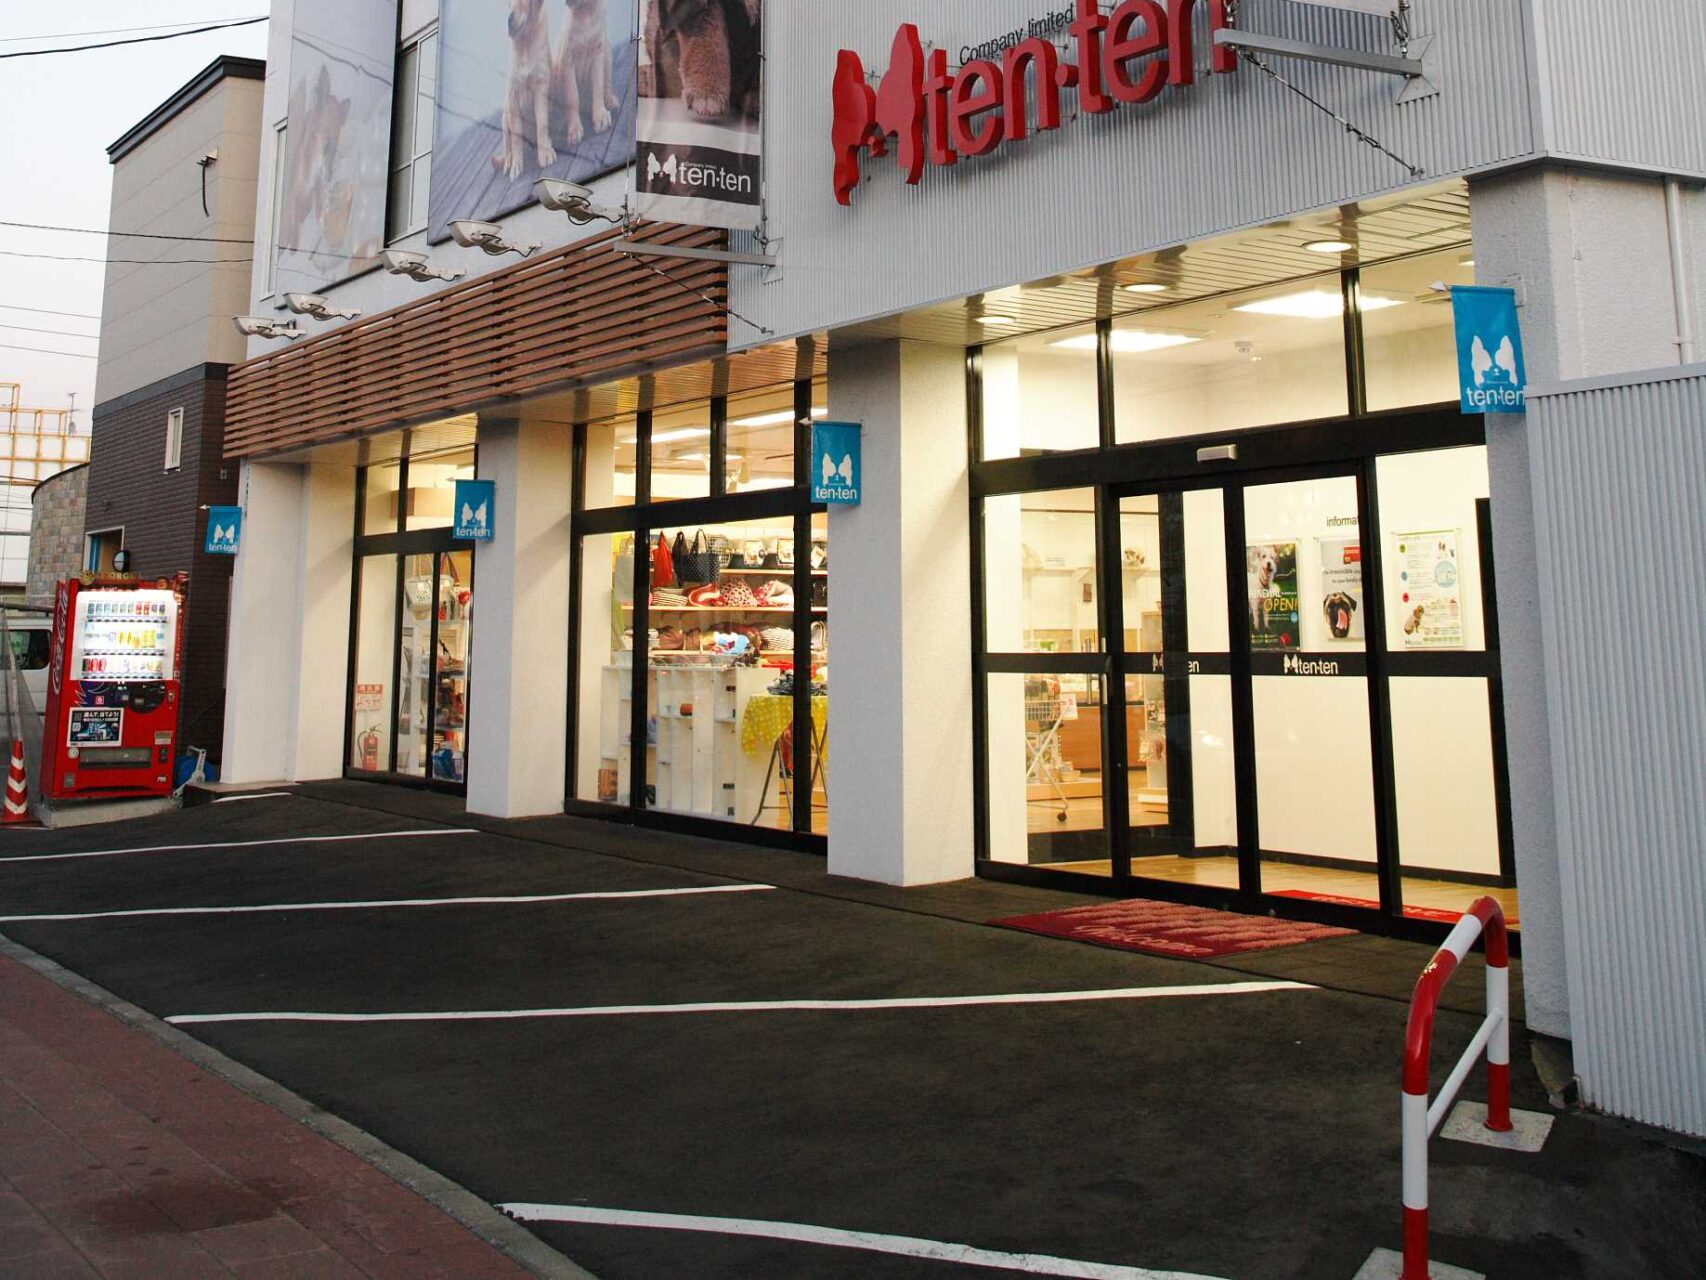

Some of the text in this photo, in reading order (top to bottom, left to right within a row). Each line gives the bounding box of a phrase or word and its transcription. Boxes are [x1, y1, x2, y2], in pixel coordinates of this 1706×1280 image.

[959, 2, 1074, 66] Company limited
[1326, 515, 1358, 527] informa
